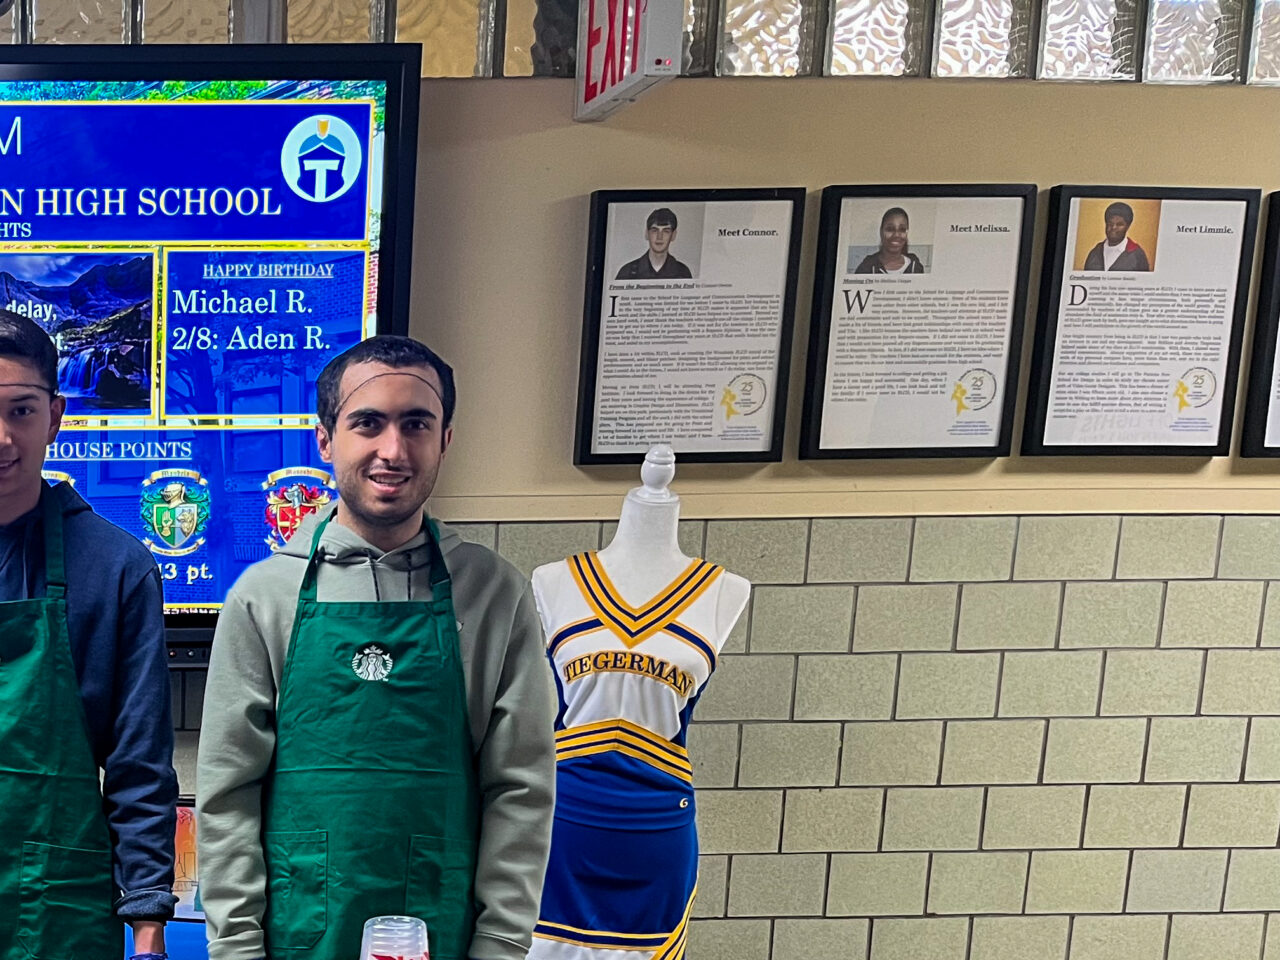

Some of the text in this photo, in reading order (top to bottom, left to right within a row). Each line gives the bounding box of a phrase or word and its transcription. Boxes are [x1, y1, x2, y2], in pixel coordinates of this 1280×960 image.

[36, 188, 125, 216] HIGH
[138, 188, 281, 216] SCHOOL
[718, 228, 779, 237] Meet Connor.
[950, 224, 1010, 233] Meet Melissa.
[1177, 225, 1234, 235] Meet Limmie.
[203, 263, 333, 277] HAPPY BIRTHDAY
[173, 289, 312, 313] Michael R.
[172, 325, 331, 351] 2/8: Aden R.
[46, 442, 192, 458] HOUSE POINTS
[187, 563, 213, 584] pt.
[563, 651, 693, 694] TIEGERMAN
